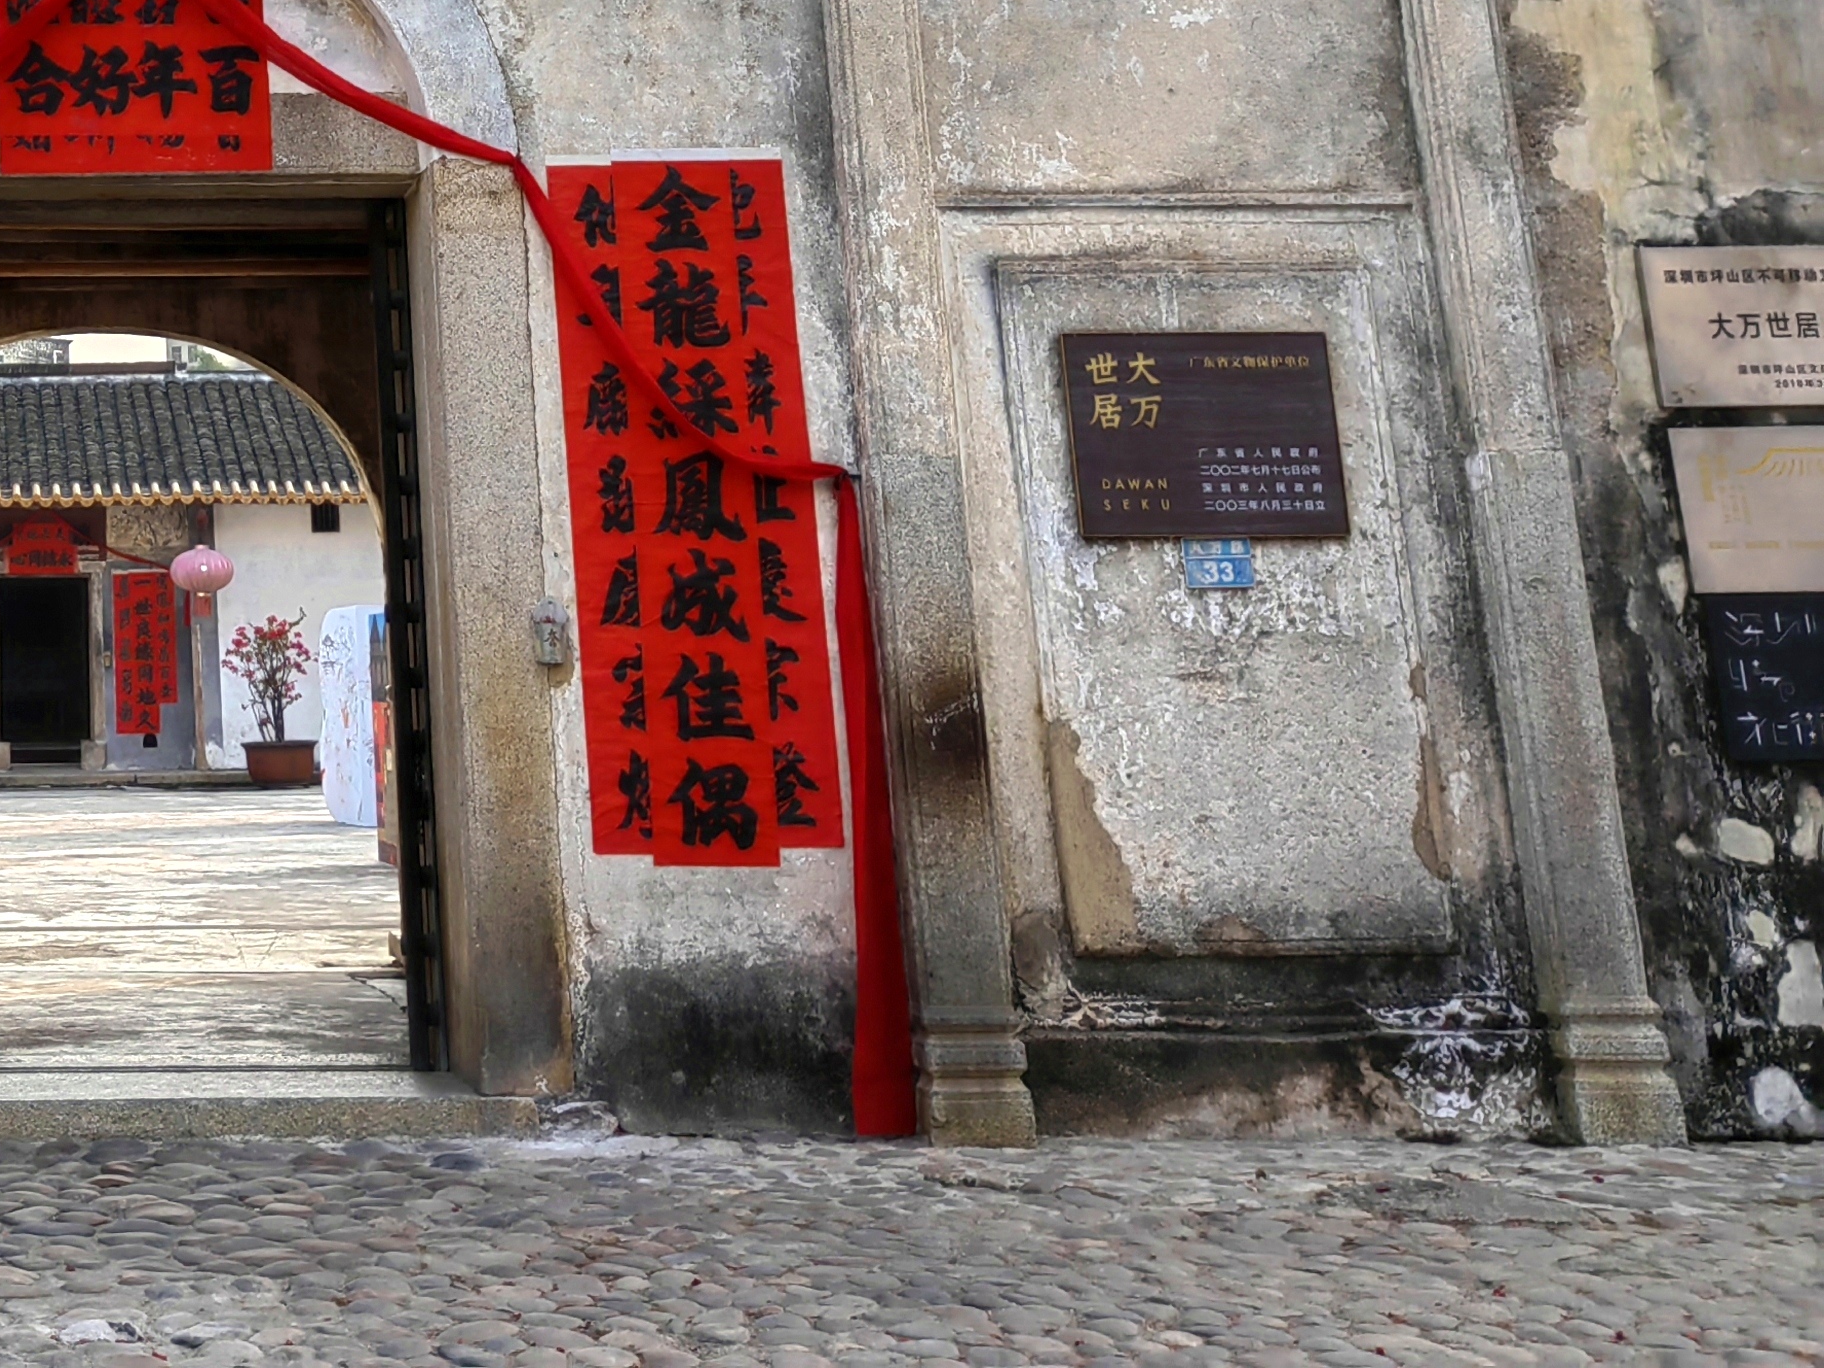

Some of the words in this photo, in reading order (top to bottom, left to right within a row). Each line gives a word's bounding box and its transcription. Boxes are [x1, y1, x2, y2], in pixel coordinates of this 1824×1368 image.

[7, 40, 261, 118] 百年好合
[1708, 312, 1820, 339] 大万世居
[1189, 356, 1310, 369] 广东省文物保护单位
[1198, 447, 1319, 459] 广东省人民政府
[1102, 478, 1168, 490] DAWAN
[1202, 482, 1323, 494] 深圳市人民政府
[1103, 498, 1171, 511] SEKU
[1200, 560, 1235, 584] 33
